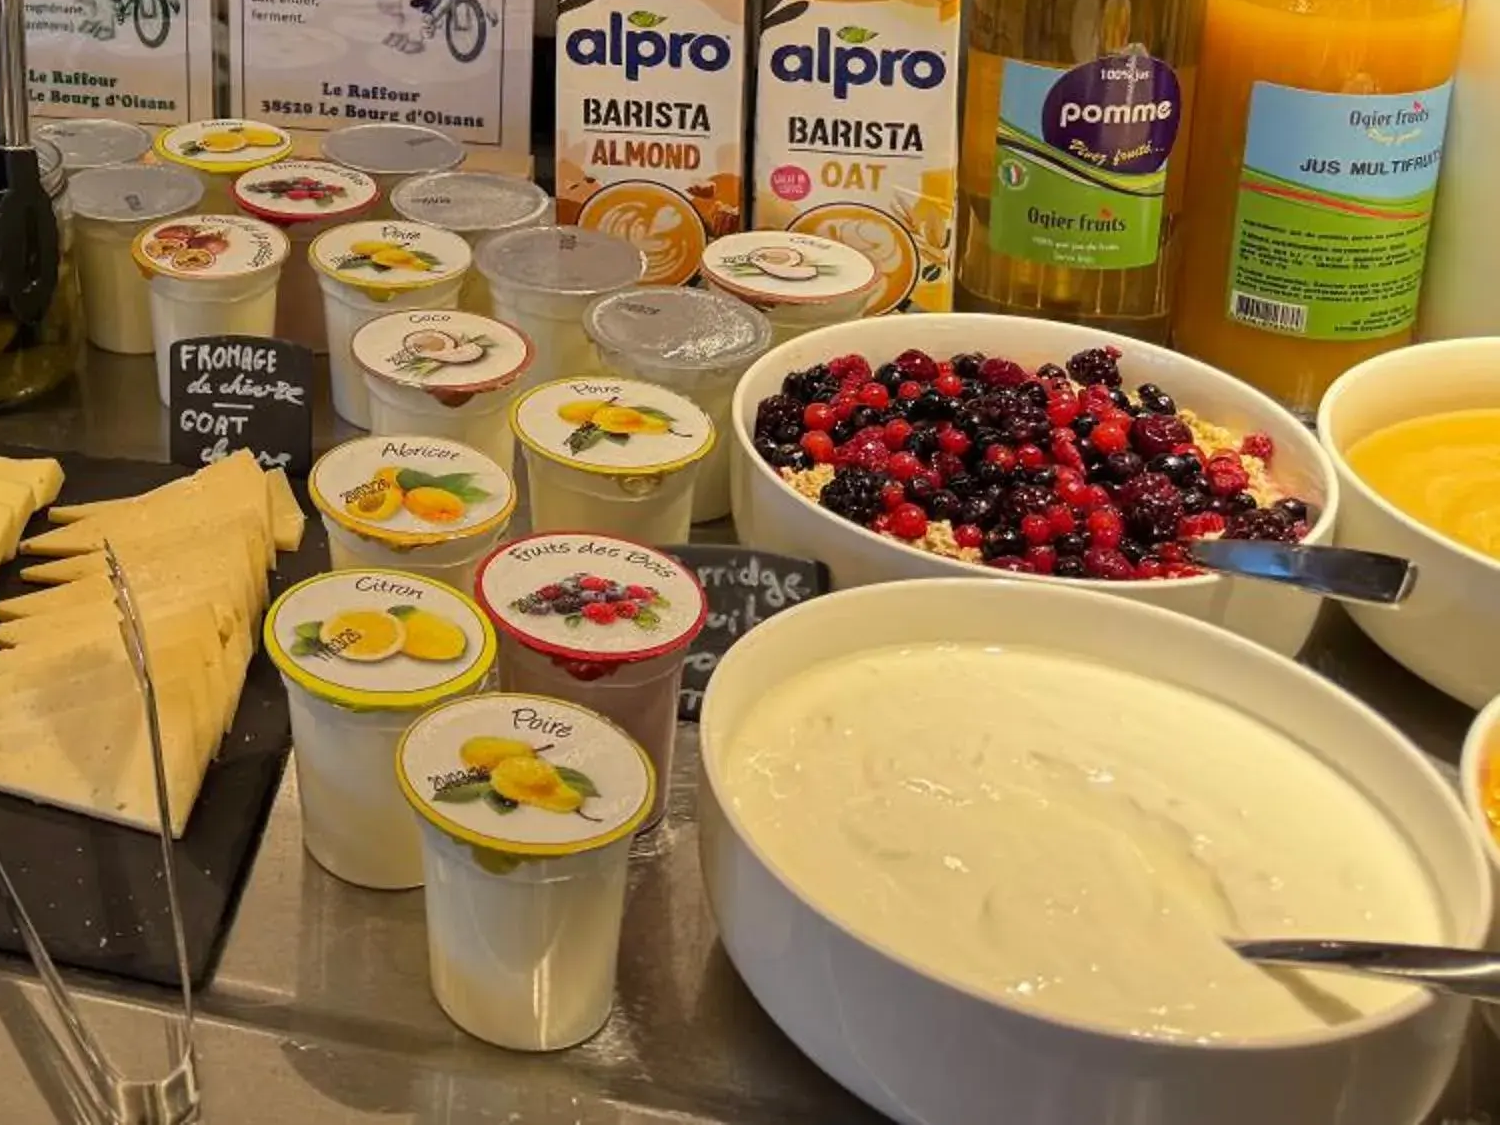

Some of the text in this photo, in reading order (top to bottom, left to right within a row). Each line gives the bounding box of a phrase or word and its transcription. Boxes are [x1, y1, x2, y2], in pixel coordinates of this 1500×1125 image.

[565, 11, 731, 81] alpro
[29, 69, 47, 83] Le
[770, 26, 946, 100] alpro
[50, 90, 100, 107] Bourg
[322, 82, 420, 102] Le Raffour
[319, 102, 338, 116] Le
[345, 105, 399, 122] Bourg
[583, 98, 711, 132] BARISTA
[1060, 100, 1172, 128] pomme
[788, 116, 924, 152] BARISTA
[590, 138, 701, 171] ALMOND
[1300, 158, 1341, 174] JUS
[820, 160, 887, 192] OAT
[180, 344, 277, 373] FROMAGE
[180, 409, 249, 435] GOAT
[355, 576, 424, 600] Citron
[697, 555, 811, 608] rridge
[511, 707, 573, 738] Poire
